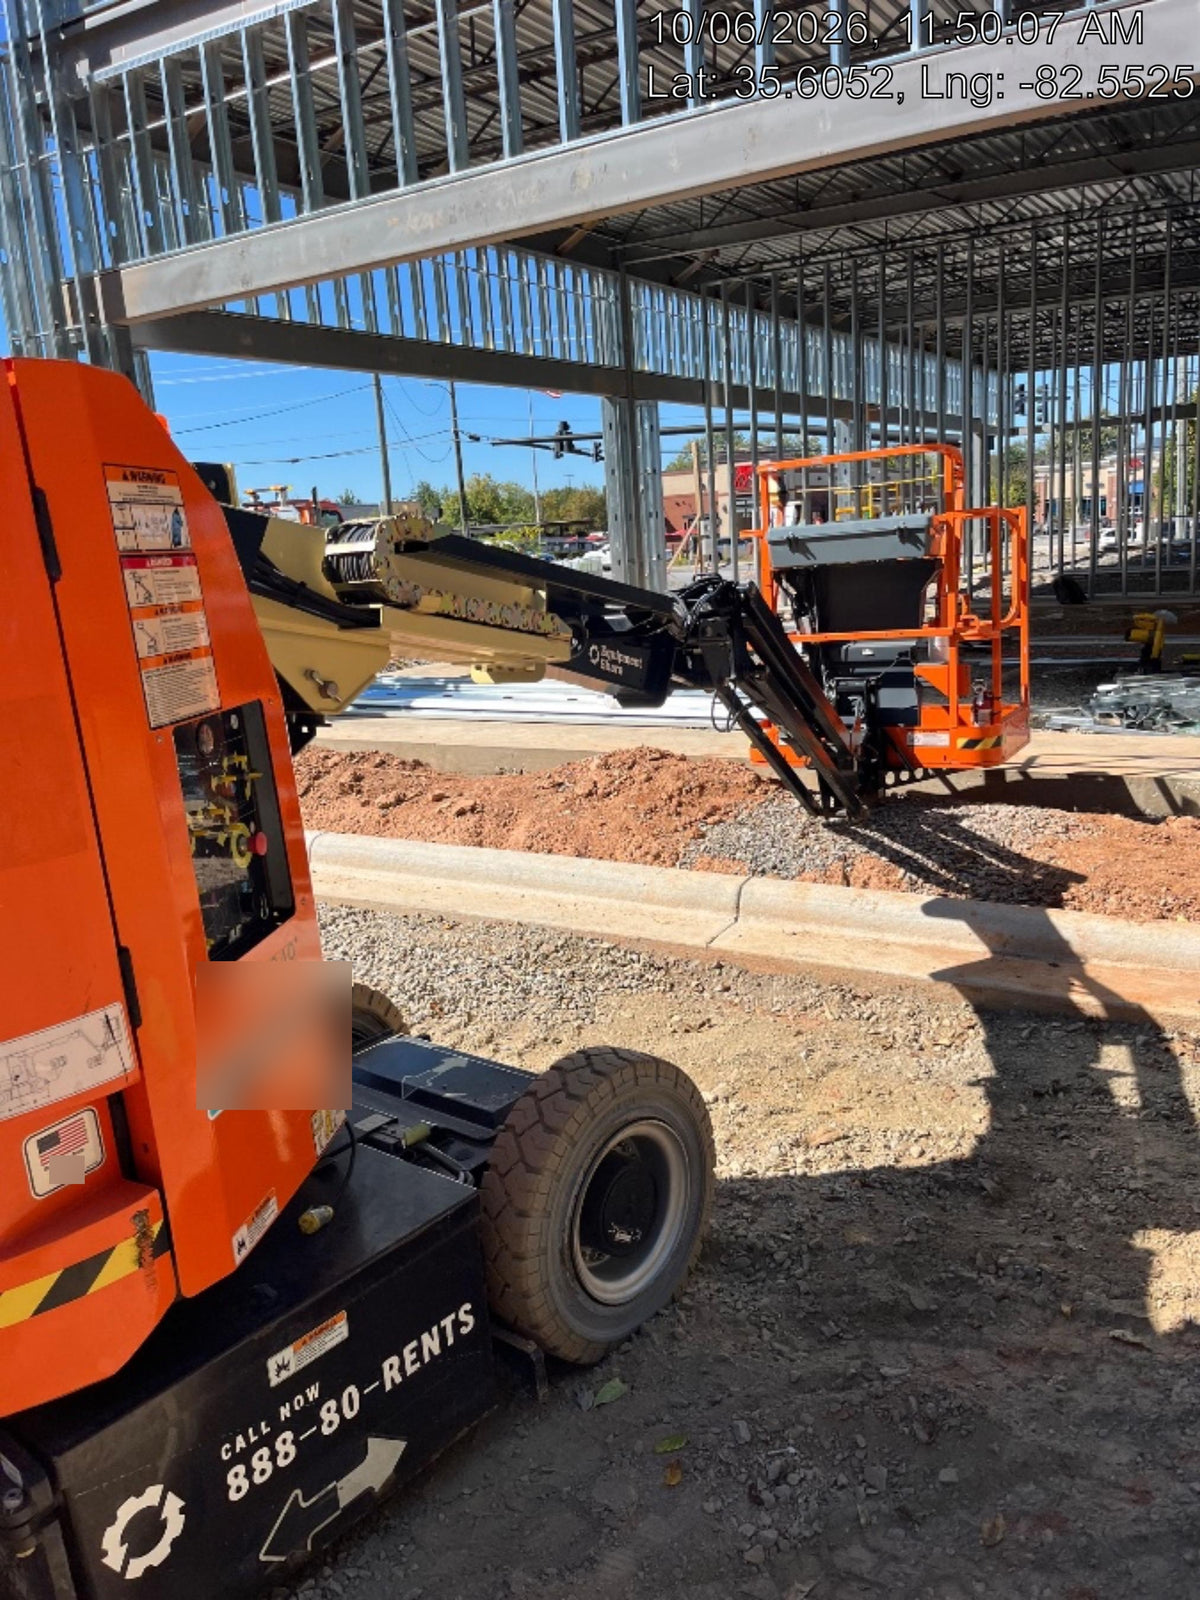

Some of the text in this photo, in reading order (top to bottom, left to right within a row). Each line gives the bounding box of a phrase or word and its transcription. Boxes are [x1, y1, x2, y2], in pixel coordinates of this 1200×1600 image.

[221, 1382, 320, 1460] CALL NOW
[227, 1303, 475, 1501] 888-80-RENTS
